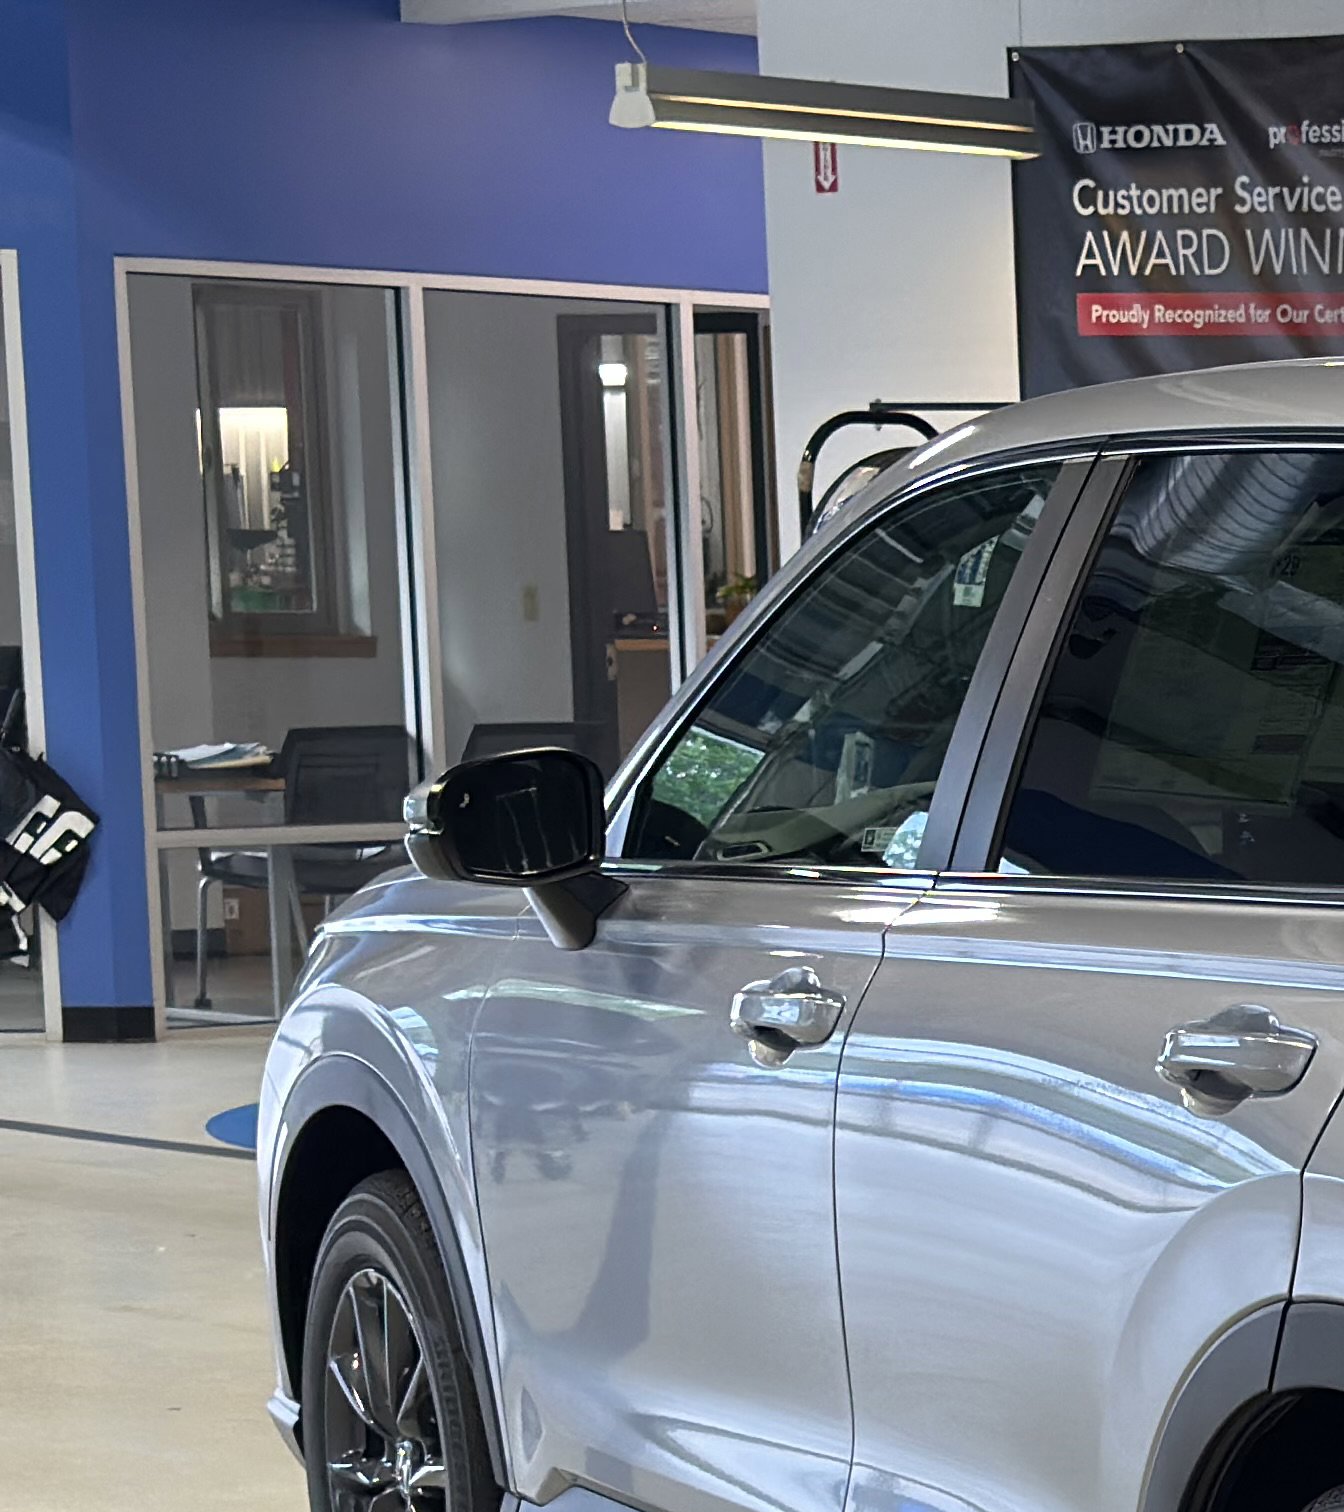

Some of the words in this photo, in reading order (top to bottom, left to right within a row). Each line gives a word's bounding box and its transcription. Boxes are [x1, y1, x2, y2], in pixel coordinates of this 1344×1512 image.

[1099, 123, 1227, 149] HONDA
[1072, 178, 1223, 216] Customer
[1233, 174, 1343, 214] Service
[1075, 228, 1231, 277] AWARD
[1091, 303, 1150, 329] Proudly
[1154, 303, 1246, 329] Recognized
[1249, 303, 1271, 323] for
[1276, 304, 1310, 324] Our
